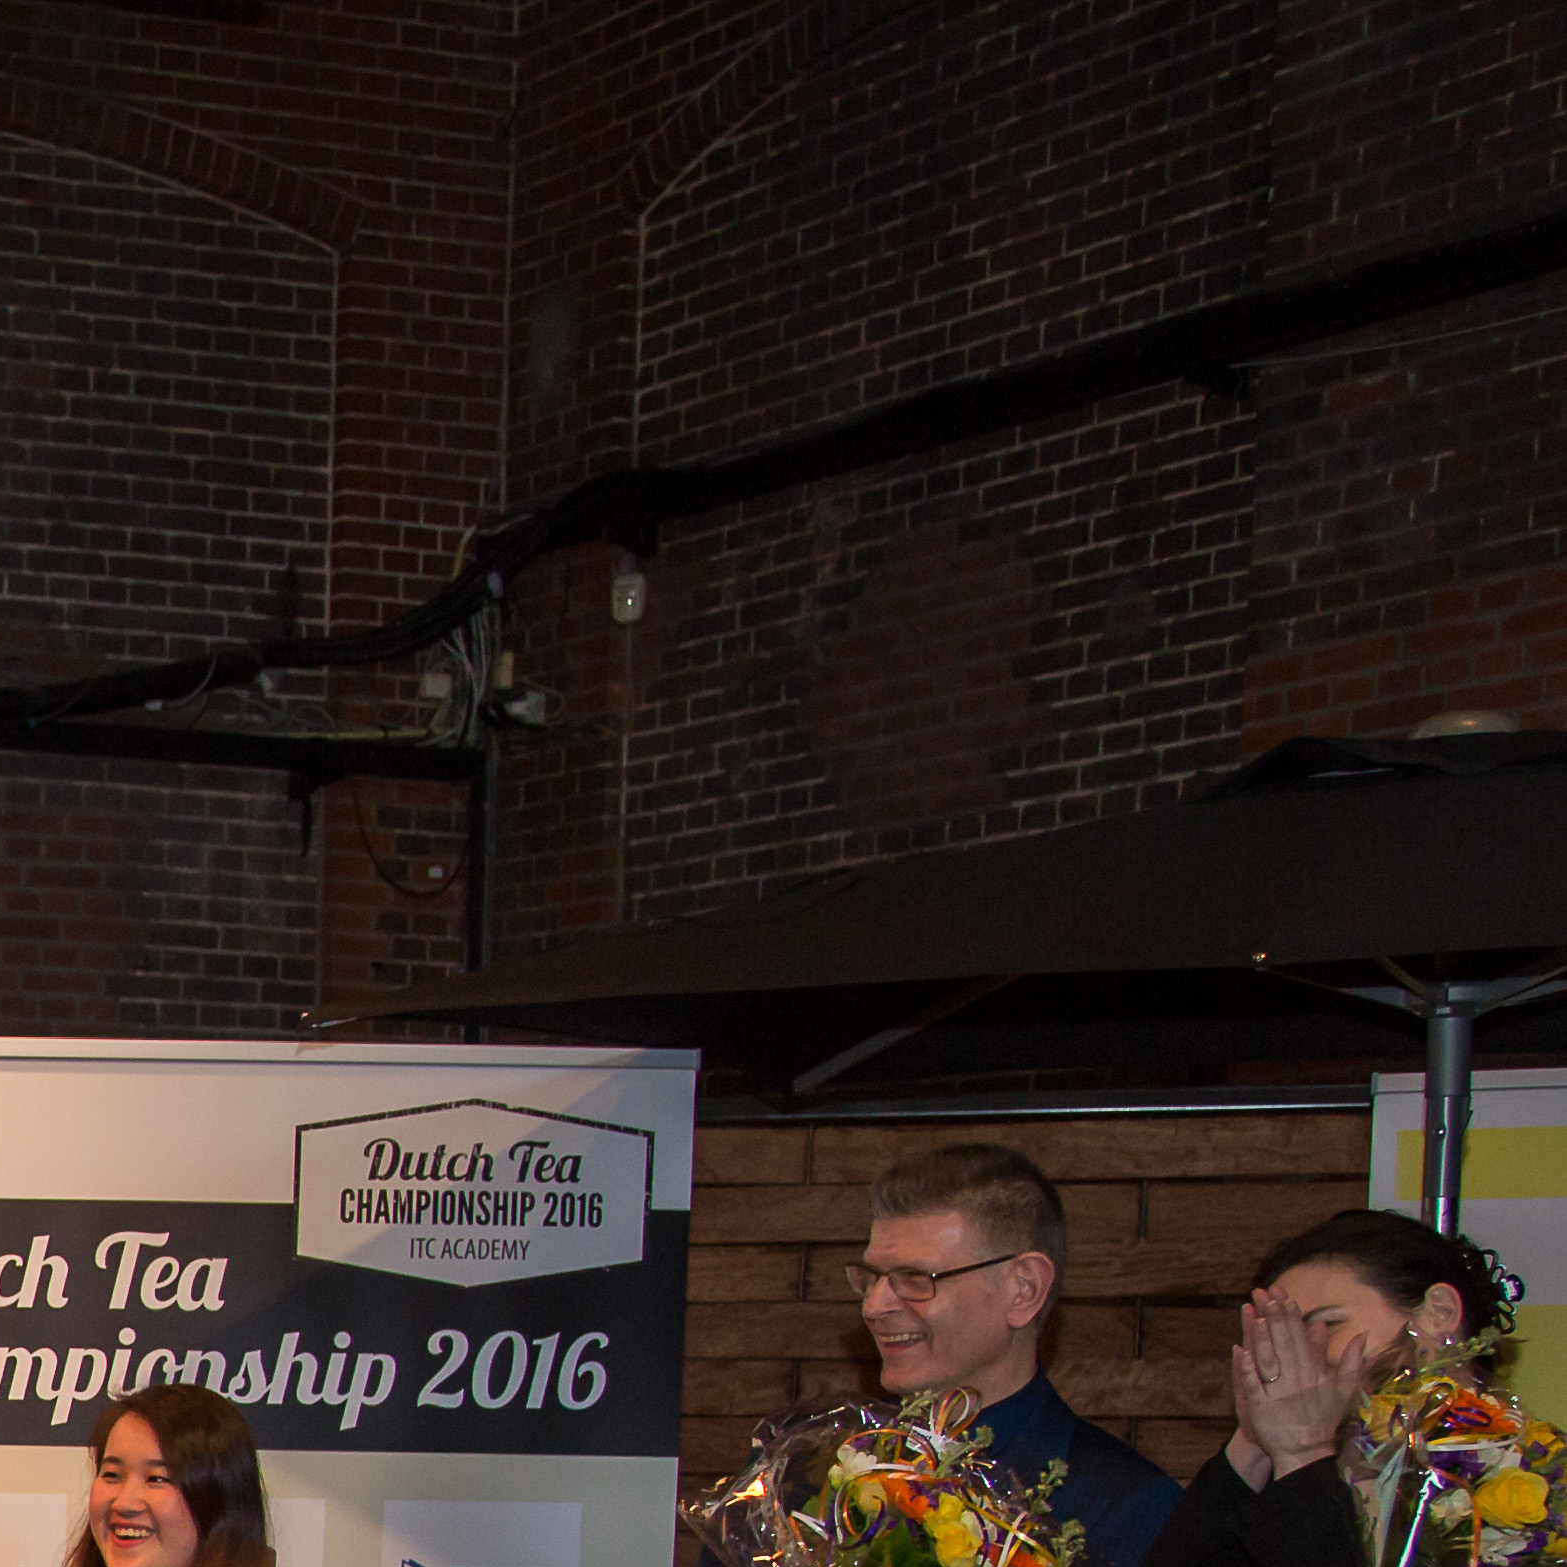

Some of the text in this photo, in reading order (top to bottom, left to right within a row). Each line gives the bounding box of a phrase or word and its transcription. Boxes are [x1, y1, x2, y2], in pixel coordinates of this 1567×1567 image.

[363, 1138, 583, 1184] Dutch Tea
[339, 1187, 603, 1228] CHAMPIONSHIP 2016
[93, 1230, 229, 1312] Tea
[409, 1237, 531, 1261] ITC ACADEMY
[416, 1328, 610, 1411] 2016
